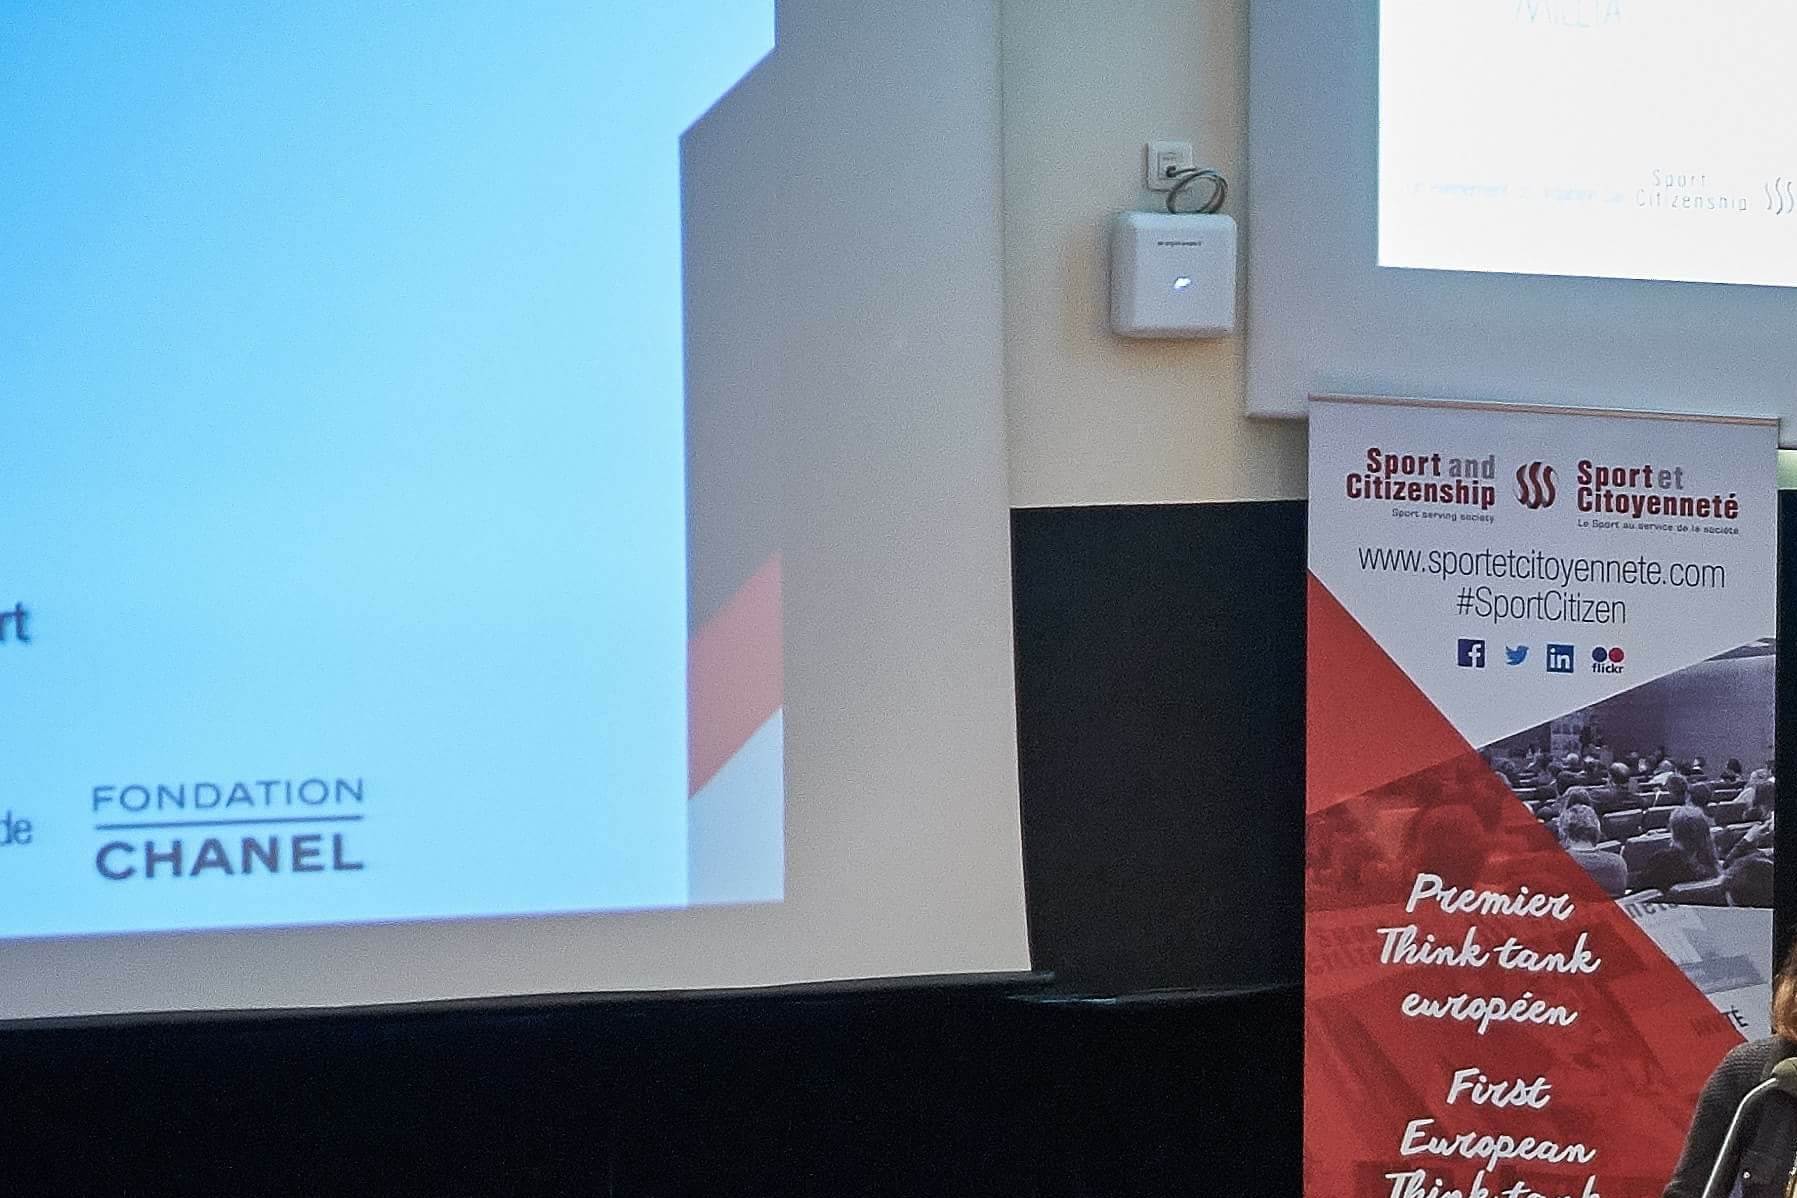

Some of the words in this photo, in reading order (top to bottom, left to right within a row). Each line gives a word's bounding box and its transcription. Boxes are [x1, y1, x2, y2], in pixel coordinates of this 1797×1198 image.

[1366, 447, 1441, 479] Sport
[1448, 454, 1495, 479] and
[1577, 460, 1653, 491] Sport
[1658, 466, 1683, 490] et
[1346, 473, 1495, 510] Citizenship
[1577, 487, 1739, 519] Citoyenneté
[1392, 508, 1419, 518] Sport
[1359, 548, 1726, 588] www.sportetcitoyennete.com
[1457, 586, 1627, 624] #SportCitizen
[1592, 662, 1625, 674] flickr
[92, 777, 365, 813] FONDATION
[96, 832, 365, 880] CHANEL
[1405, 873, 1576, 921] Premier
[1376, 926, 1494, 968] Think
[1494, 932, 1601, 974] tank
[1402, 991, 1578, 1034] européen
[1446, 1067, 1552, 1109] First
[1400, 1118, 1596, 1171] European
